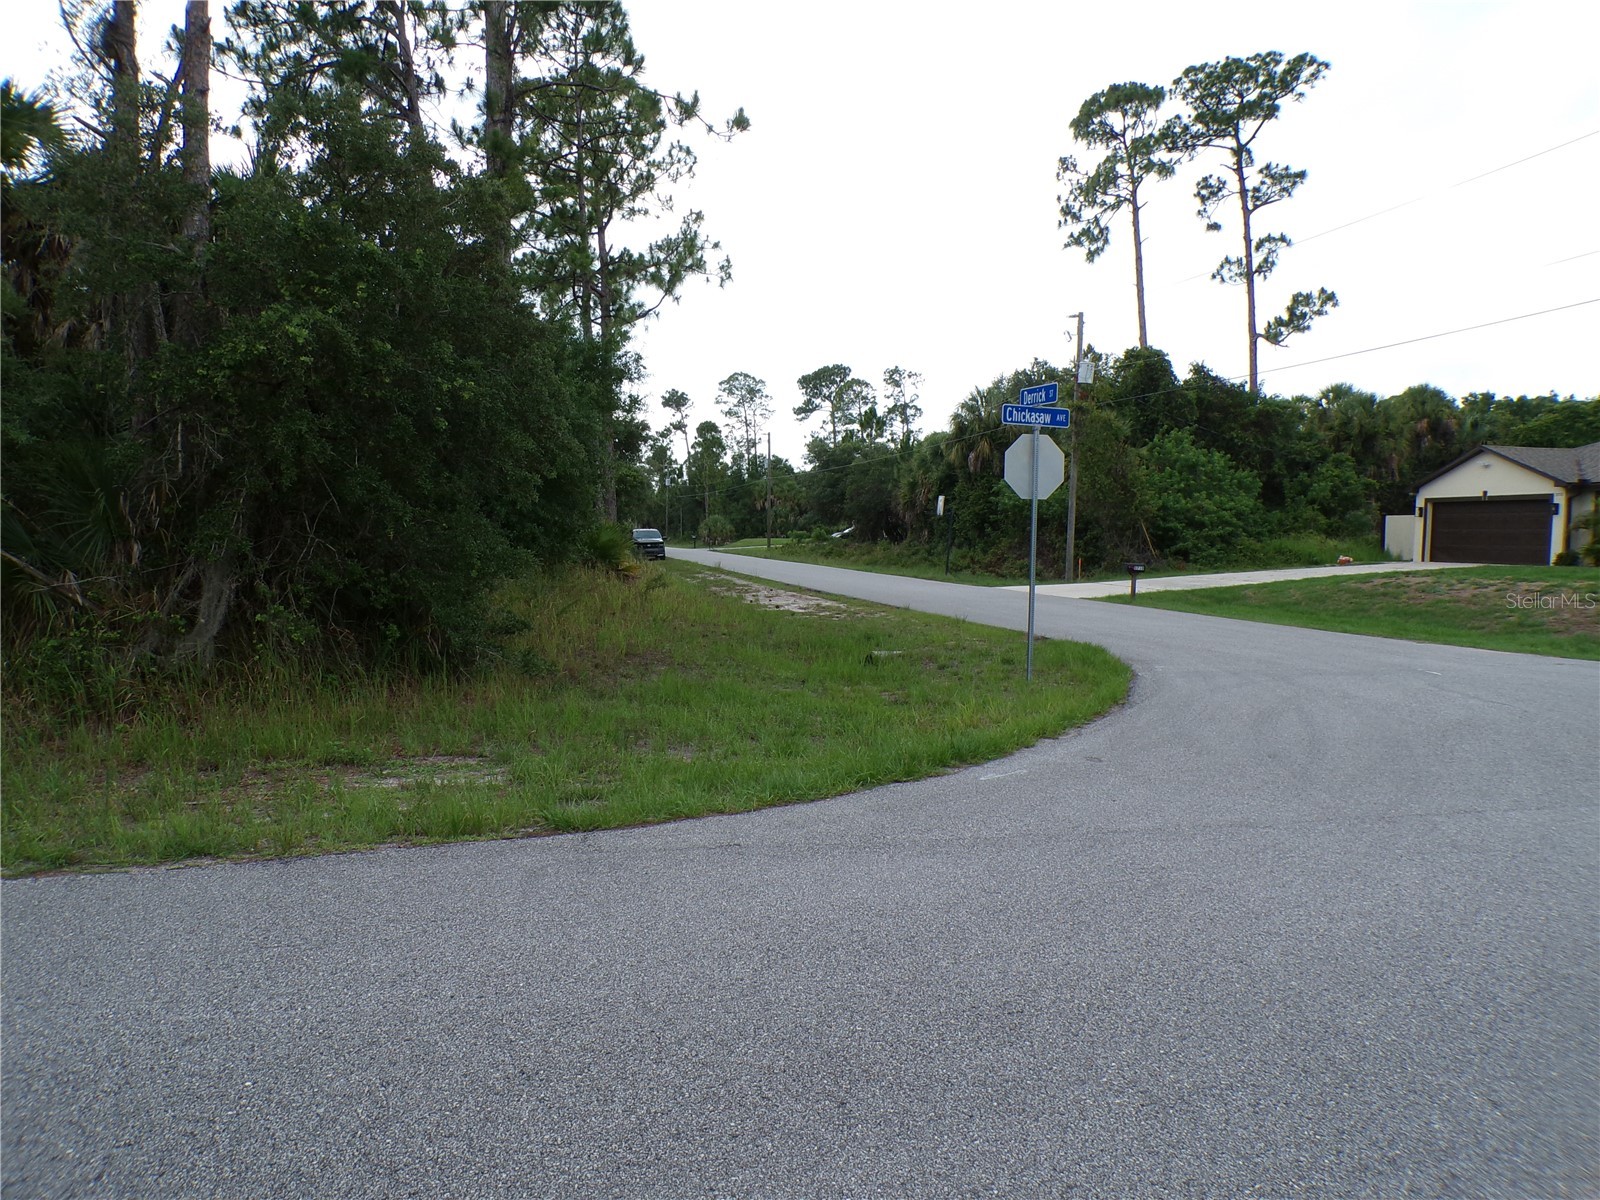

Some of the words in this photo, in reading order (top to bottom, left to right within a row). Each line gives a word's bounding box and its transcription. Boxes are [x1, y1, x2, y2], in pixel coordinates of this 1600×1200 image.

[1023, 388, 1046, 405] Derrick
[1049, 389, 1054, 398] ST
[1006, 407, 1051, 424] Chickasaw
[1056, 414, 1066, 422] AVE
